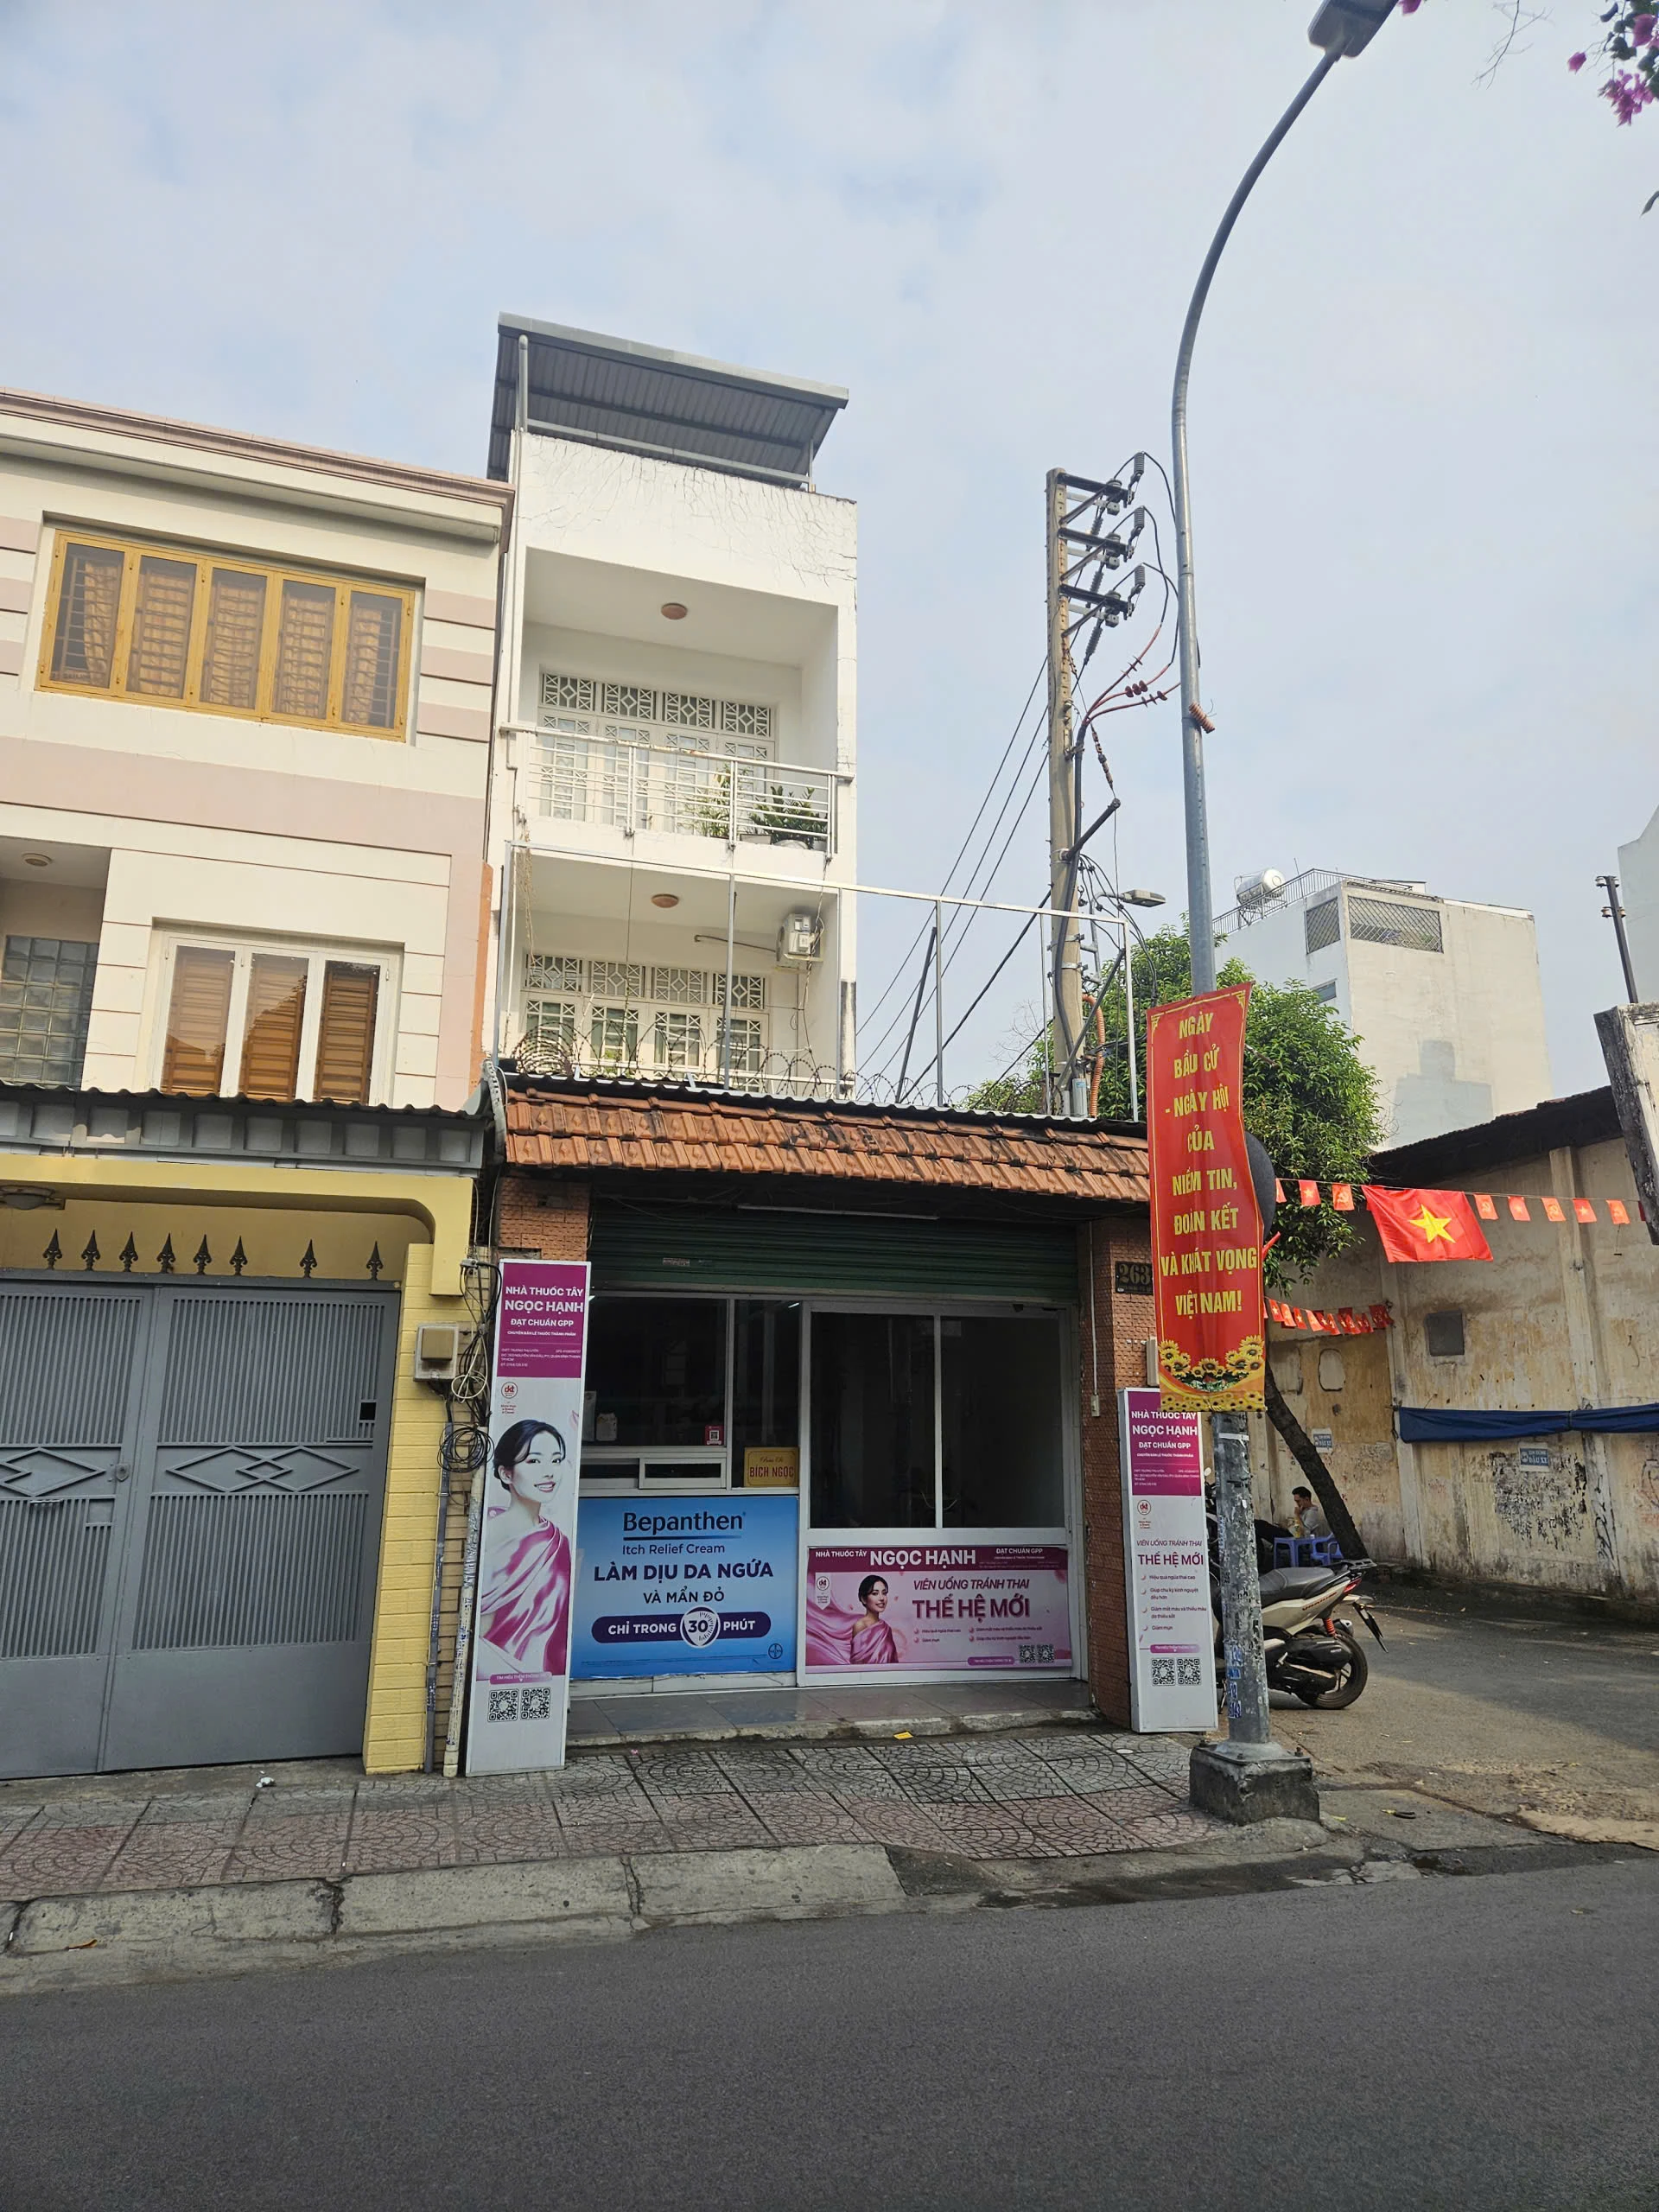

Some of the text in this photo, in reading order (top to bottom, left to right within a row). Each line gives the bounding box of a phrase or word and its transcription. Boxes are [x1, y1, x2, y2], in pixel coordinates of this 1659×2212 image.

[1179, 1011, 1214, 1039] NGÀY
[1174, 1043, 1220, 1079] BẦU CỬ
[1173, 1089, 1208, 1117] NGÀY
[1212, 1083, 1230, 1113] HỘI
[1187, 1124, 1215, 1154] CỦA
[1206, 1167, 1237, 1191] TIN,
[1211, 1202, 1238, 1230] KẾT
[1160, 1247, 1257, 1276] VÀ KHÁT VỌNG
[1119, 1264, 1150, 1286] 263
[505, 1285, 584, 1296] NHÀ THUỐC TÂY
[505, 1300, 584, 1314] NGỌC HẠNH
[1175, 1289, 1242, 1319] VIỆT NAM!
[511, 1319, 527, 1327] ĐẠT
[1131, 1409, 1149, 1419] NHÀ
[1132, 1425, 1198, 1438] NGỌC HẠNH
[623, 1511, 743, 1535] Bepanthen
[622, 1543, 725, 1555] Itch Relief Cream
[870, 1549, 976, 1569] NGỌC HẠNH
[1138, 1551, 1204, 1567] THẾ HỆ MỚI
[594, 1558, 773, 1583] LÀM DỊU DA NGỨA
[913, 1576, 1030, 1590] VIÊN UỐNG TRÁNH THAI
[643, 1586, 724, 1604] VÀ MẨN ĐỎ
[912, 1592, 1030, 1623] THẾ HỆ MỚI
[607, 1618, 756, 1635] CHỈ TRONG 30 PHÚT
